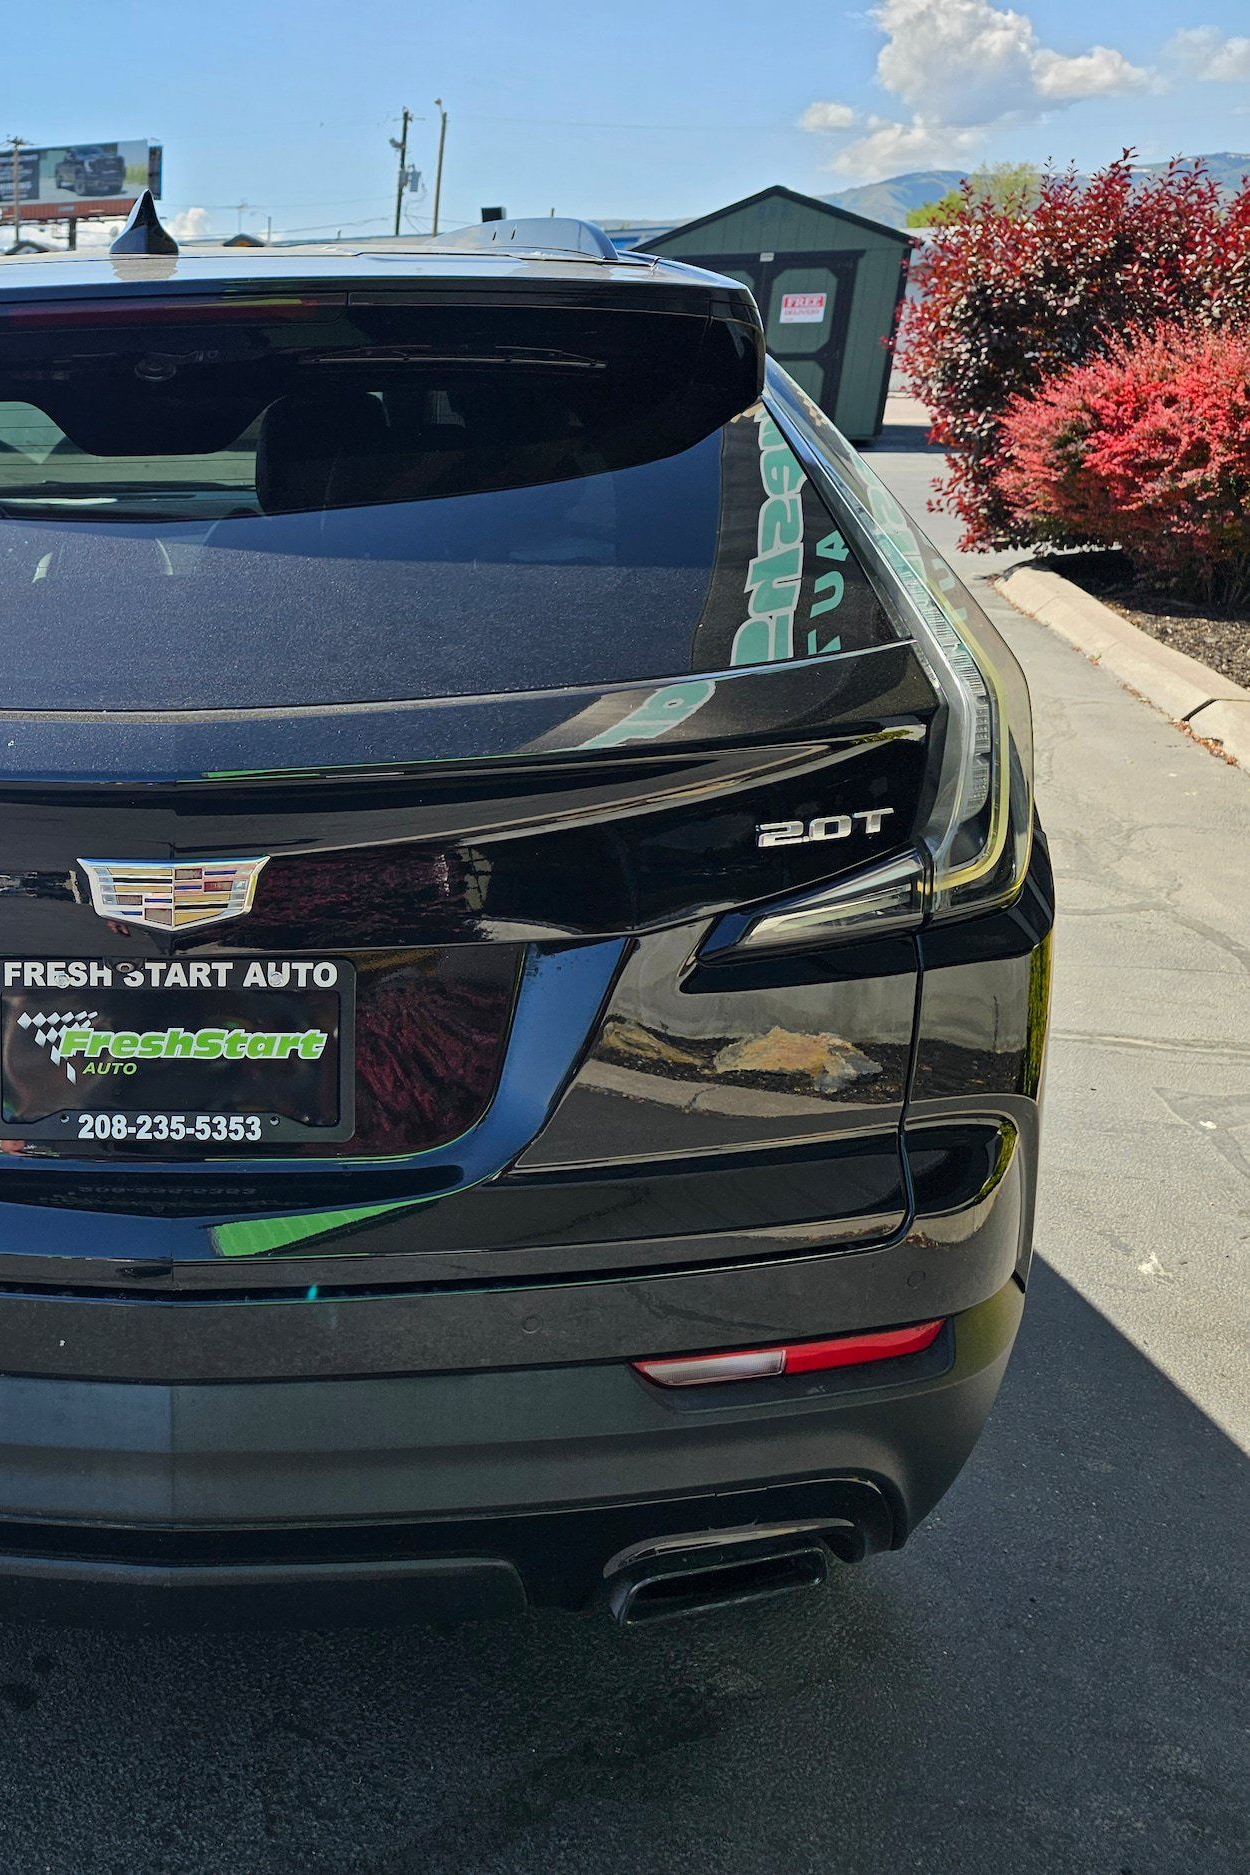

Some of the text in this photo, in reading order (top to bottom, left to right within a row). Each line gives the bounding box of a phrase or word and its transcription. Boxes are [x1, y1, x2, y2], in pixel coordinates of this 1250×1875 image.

[756, 807, 895, 848] 2.0T
[4, 961, 338, 988] FRESH START AUTO
[59, 1028, 329, 1060] FreshStart
[82, 1062, 137, 1075] AUTO
[78, 1114, 262, 1141] 208-235-5353
